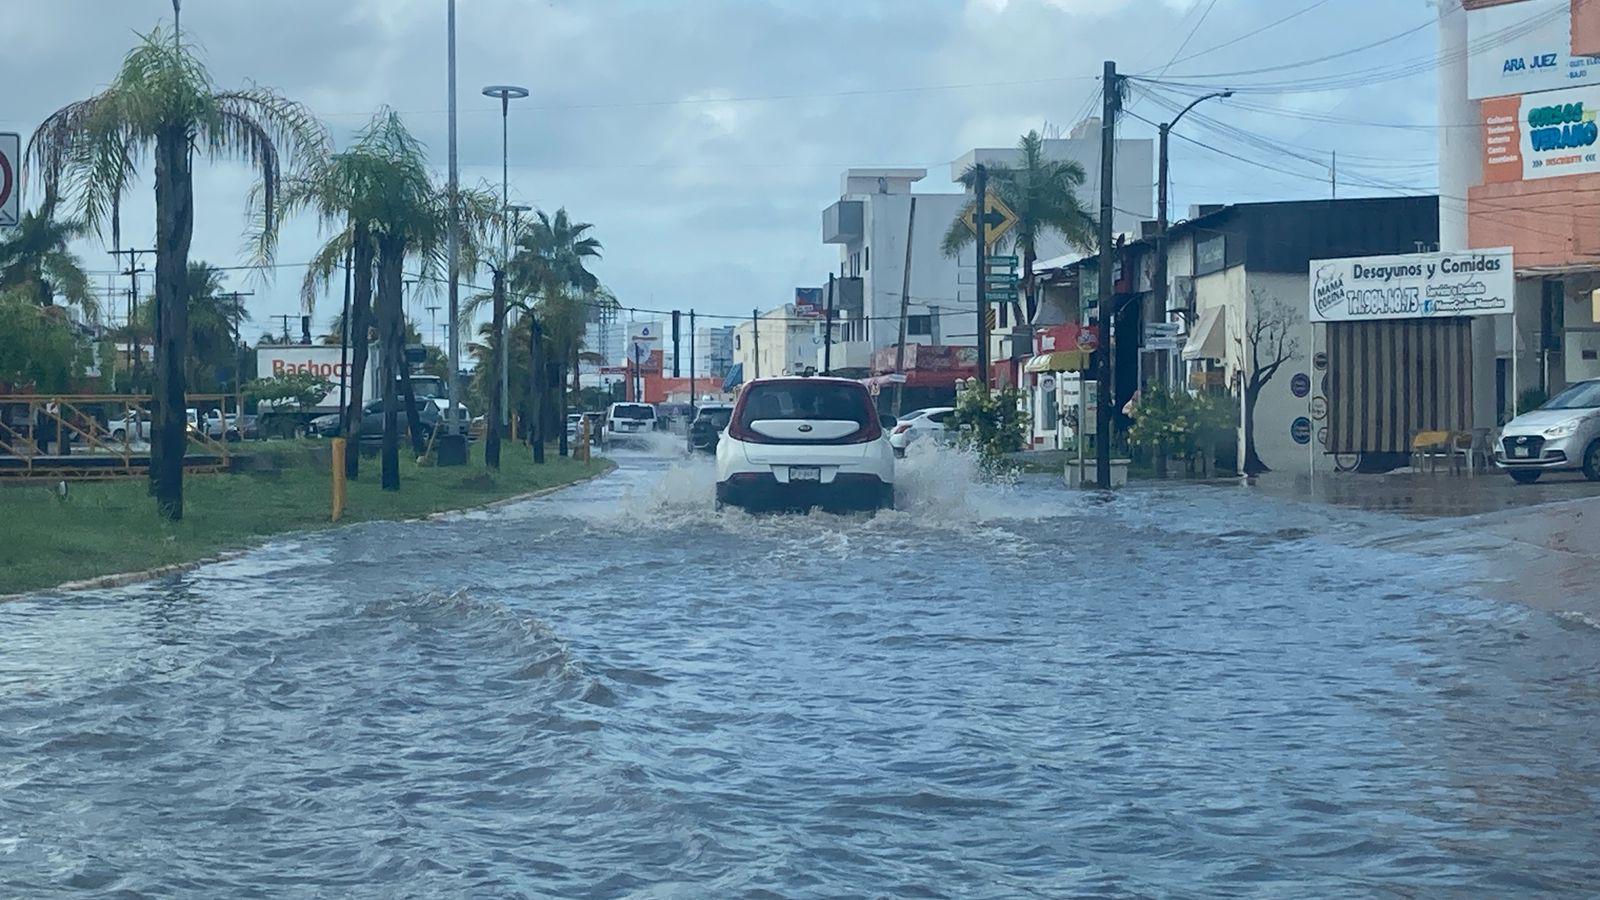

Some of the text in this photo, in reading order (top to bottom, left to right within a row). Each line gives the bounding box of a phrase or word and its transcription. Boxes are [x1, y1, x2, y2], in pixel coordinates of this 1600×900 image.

[1530, 53, 1557, 69] JUEZ
[1530, 121, 1598, 152] VERANO
[1353, 255, 1500, 282] Desayunos y Comidas
